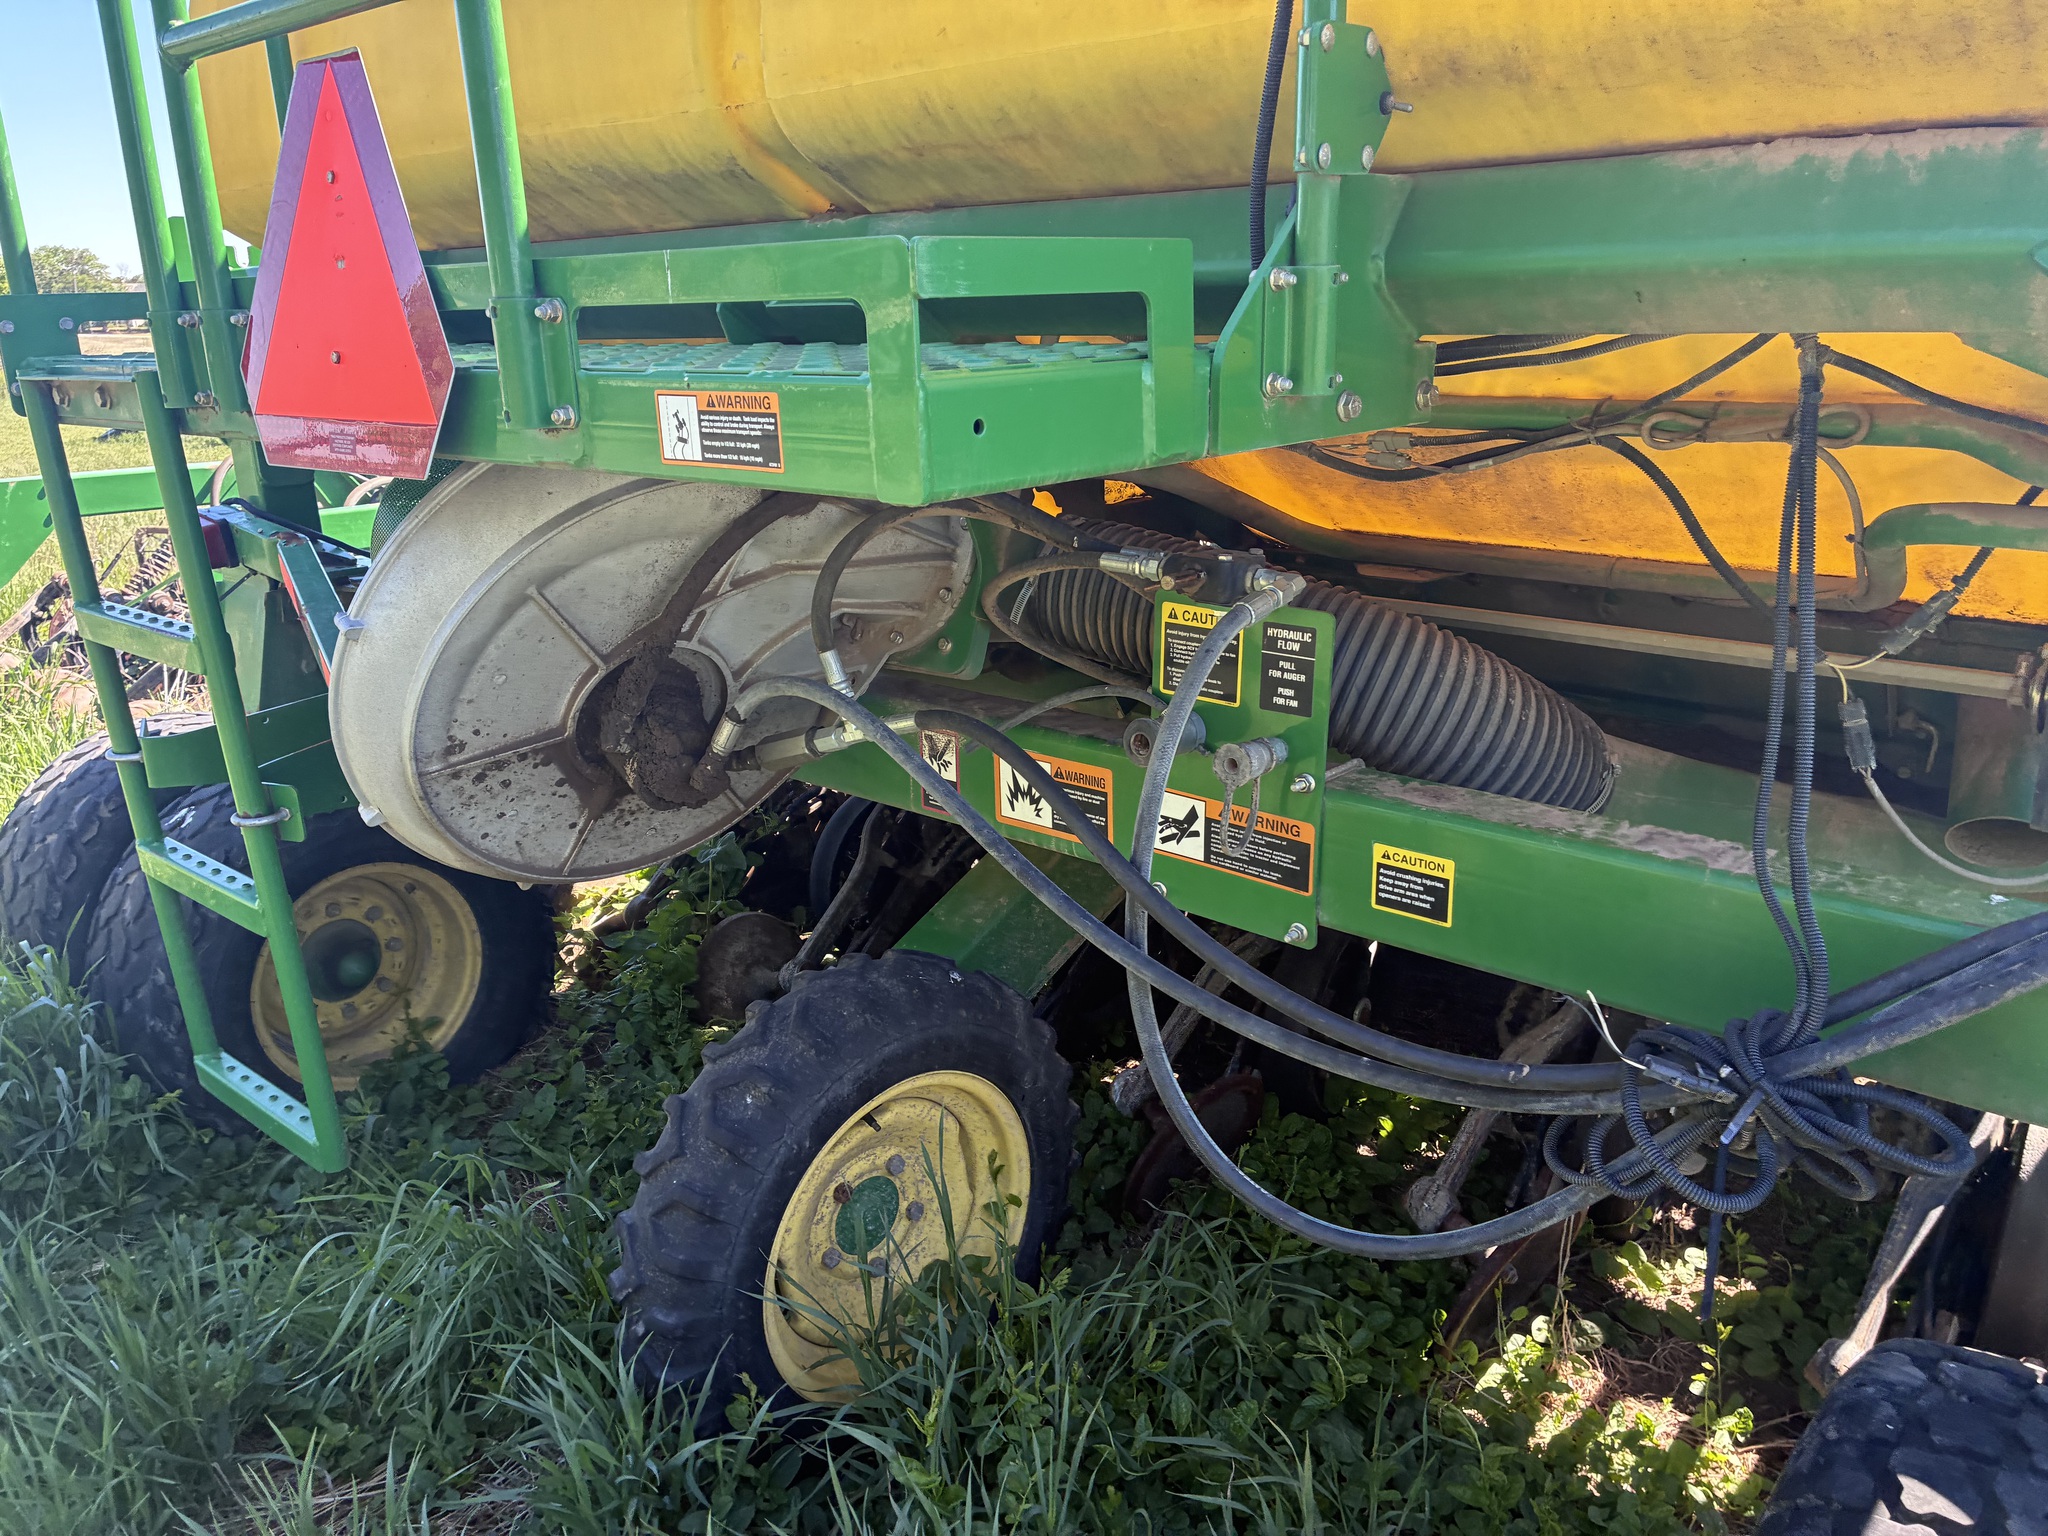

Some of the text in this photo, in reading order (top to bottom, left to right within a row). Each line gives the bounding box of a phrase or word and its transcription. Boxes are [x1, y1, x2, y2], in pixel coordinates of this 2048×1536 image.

[716, 395, 771, 410] WARNING
[1182, 610, 1214, 626] CAUT
[1267, 627, 1312, 642] HYDRAULIC
[1277, 640, 1300, 652] FLOW
[1279, 661, 1296, 670] PULL
[1268, 669, 1306, 682] FOR AUGER
[1278, 687, 1294, 697] PUSH
[1273, 697, 1298, 708] FOR FAN
[1065, 770, 1106, 789] WARNING
[1392, 853, 1445, 873] CAUTION
[1379, 868, 1445, 888] Avoid crushing injuries.
[1379, 876, 1424, 891] Keep away from
[1378, 892, 1401, 901] openers
[1412, 900, 1431, 909] raised.
[1419, 894, 1435, 902] when
